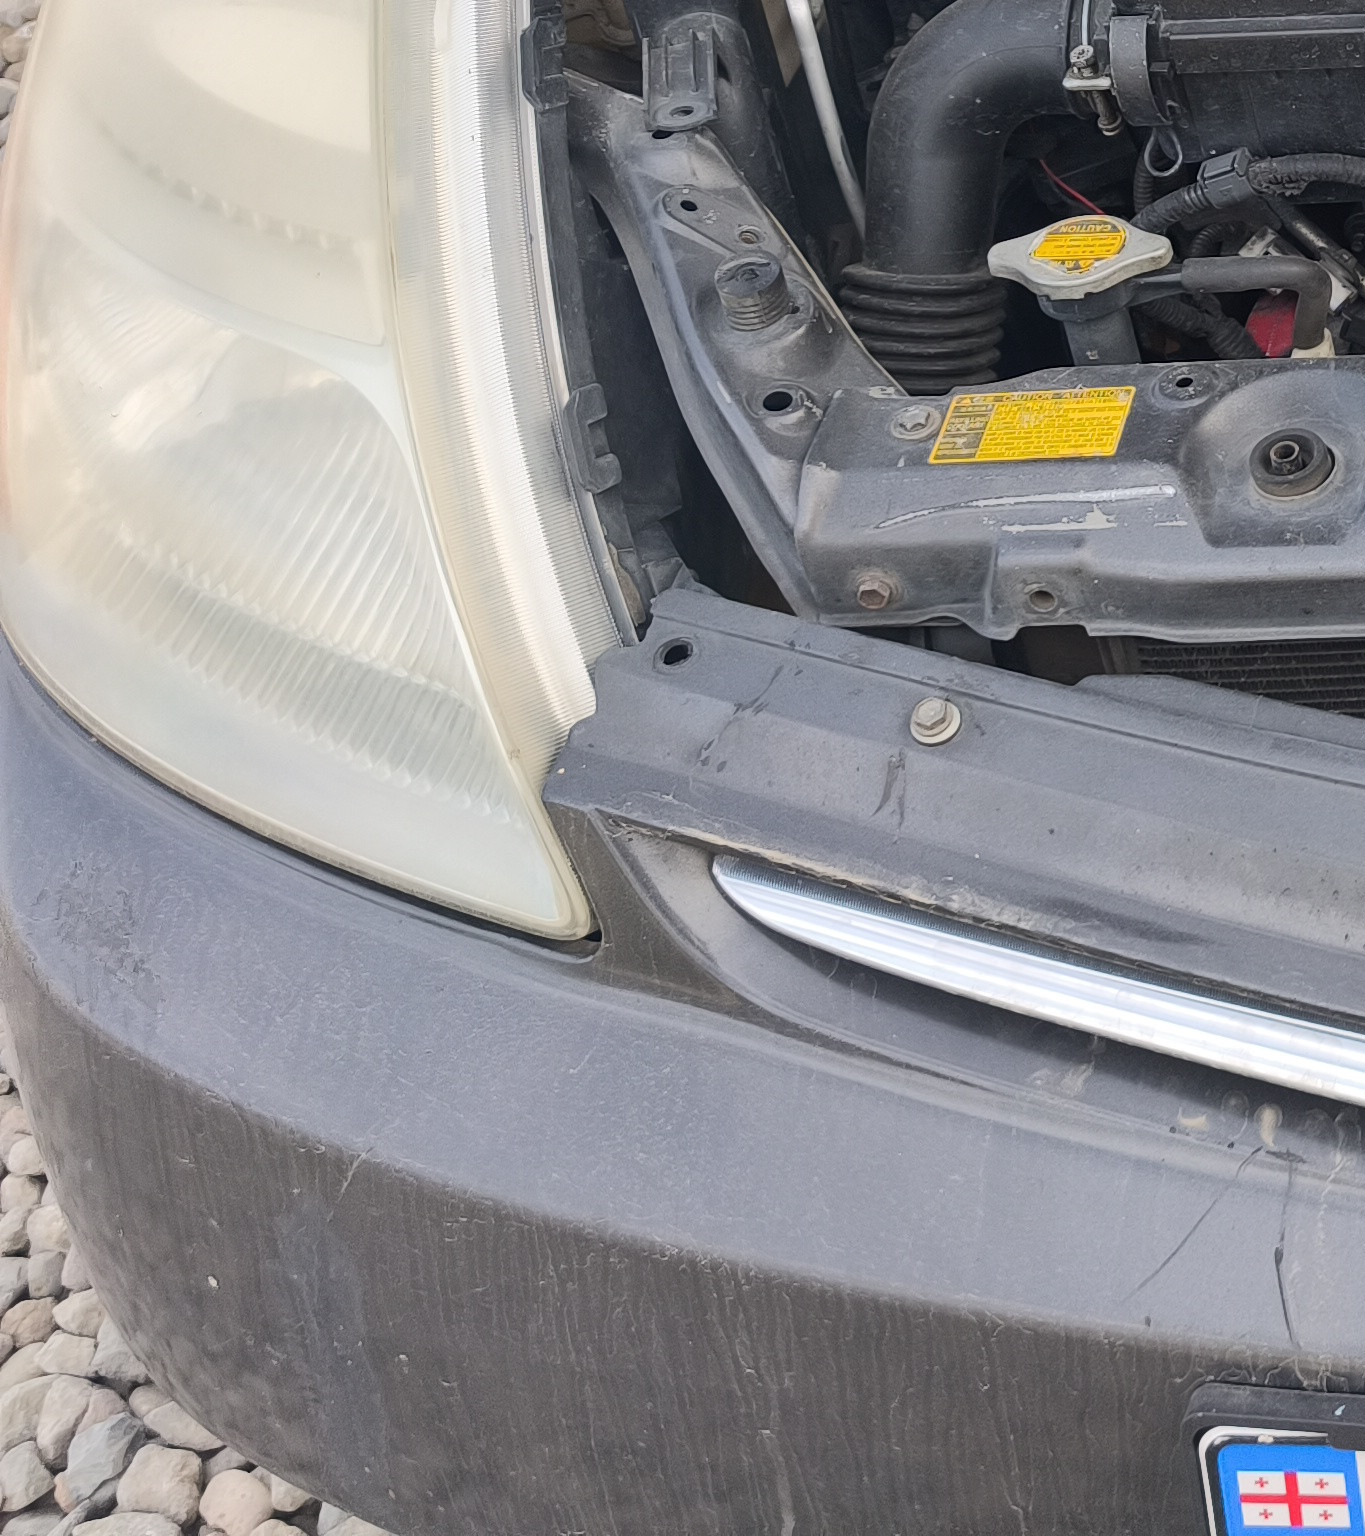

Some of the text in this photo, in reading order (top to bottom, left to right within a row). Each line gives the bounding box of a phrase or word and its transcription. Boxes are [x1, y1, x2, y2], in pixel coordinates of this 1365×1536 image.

[1059, 224, 1112, 233] CAUTION
[1002, 389, 1126, 402] CAUTION ATTENTION
